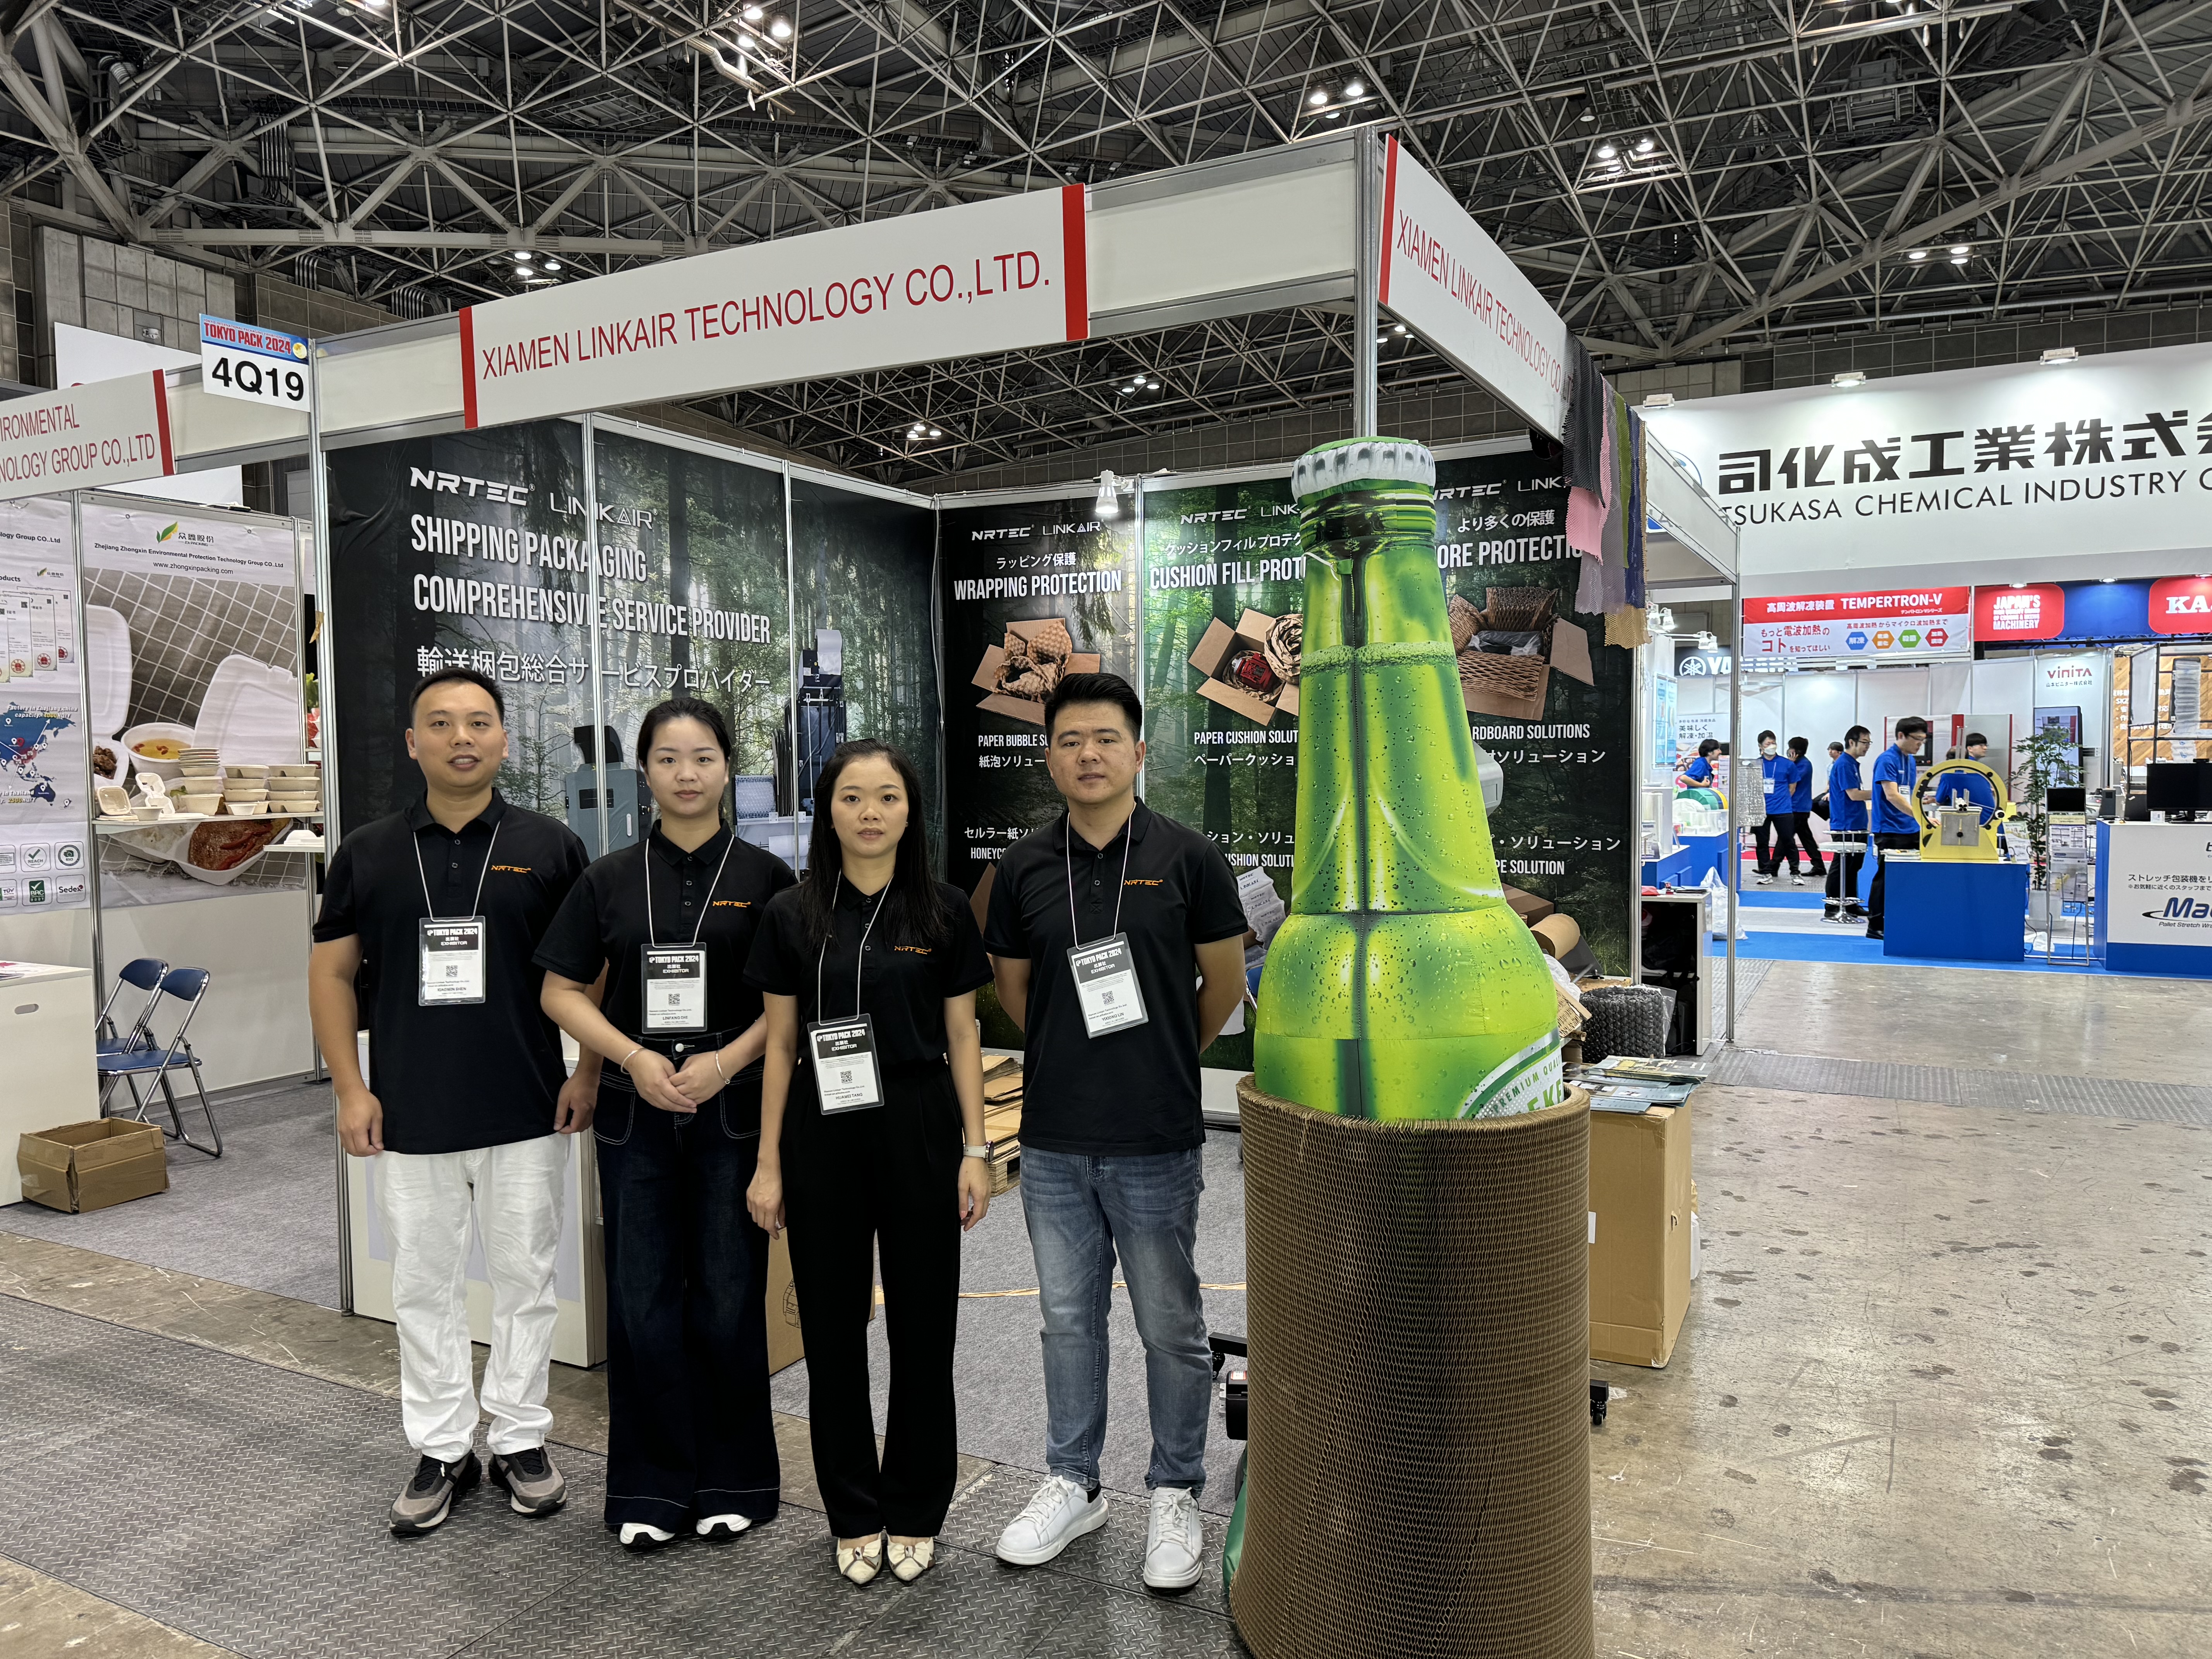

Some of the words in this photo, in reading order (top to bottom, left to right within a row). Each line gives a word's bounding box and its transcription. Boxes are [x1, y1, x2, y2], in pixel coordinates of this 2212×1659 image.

[1397, 210, 1449, 289] XIAMEN
[1451, 259, 1493, 329] LINKAIR
[1496, 300, 1550, 381] TECHNOLOGY
[483, 333, 569, 380] XIAMEN
[577, 313, 677, 361] LINKAIR
[684, 273, 894, 340] TECHNOLOGY
[905, 251, 1049, 306] CO.,LTD.
[204, 322, 235, 342] TOKYO
[238, 330, 263, 348] PACK
[265, 337, 291, 354] 2024
[212, 357, 304, 401] 4Q19
[0, 404, 80, 441] IRONMENTAL
[52, 443, 97, 474] GROUP
[102, 434, 155, 467] CO.,LTD
[1719, 410, 2212, 495] 司化成工業株式
[1518, 476, 1566, 492] LINK
[1855, 485, 2012, 516] CHEMICAL
[2025, 470, 2187, 504] INDUSTRY
[1261, 503, 1302, 517] LINK
[1043, 521, 1100, 536] LINKAIR
[1457, 510, 1555, 533] より多くの保護
[94, 543, 119, 551] Zhejiang
[149, 549, 187, 558] Environmental
[217, 556, 246, 565] Technology
[411, 514, 519, 564] SHIPPING
[526, 531, 647, 581] PACKAGING
[1435, 542, 1473, 569] ORE
[153, 562, 233, 574] www.zhongxinpacking.com
[997, 552, 1076, 570] ラッピング保護
[1150, 563, 1217, 589] CUSHION
[1223, 560, 1255, 584] FILL
[954, 576, 1027, 600] WRAPPING
[1032, 570, 1122, 596] PROTECTION
[1841, 593, 1942, 610] TEMPERTRON-V
[1994, 595, 2040, 610] JAPAN'S
[2166, 596, 2212, 613] KA
[612, 598, 688, 636] SERVICE
[692, 607, 770, 644] PROVIDER
[1993, 620, 2039, 630] MACHINERY
[1761, 624, 1830, 637] もっと電波加熱の
[978, 735, 1004, 747] PAPER
[1006, 734, 1037, 746] BUBBLE
[1194, 732, 1223, 745] PAPER
[1226, 730, 1266, 744] CUSHION
[1472, 725, 1524, 740] RDBOARD
[1527, 724, 1590, 739] SOLUTIONS
[979, 755, 1045, 768] 紙泡ソリュー
[1194, 753, 1294, 766] ペーパークッショ
[964, 827, 1039, 840] セルラー紙ソ
[1491, 834, 1621, 851] ・ソリューション
[1510, 859, 1565, 875] SOLUTION
[2163, 897, 2212, 918] Ma
[1080, 955, 1096, 965] TOKYO
[1096, 952, 1109, 961] PACK
[1109, 948, 1122, 957] 2024
[822, 1033, 838, 1041] TOKYO
[838, 1030, 852, 1039] PACK
[852, 1029, 866, 1037] 2024
[1492, 1072, 1539, 1113] PREMIUM
[1543, 1054, 1561, 1075] QUALI
